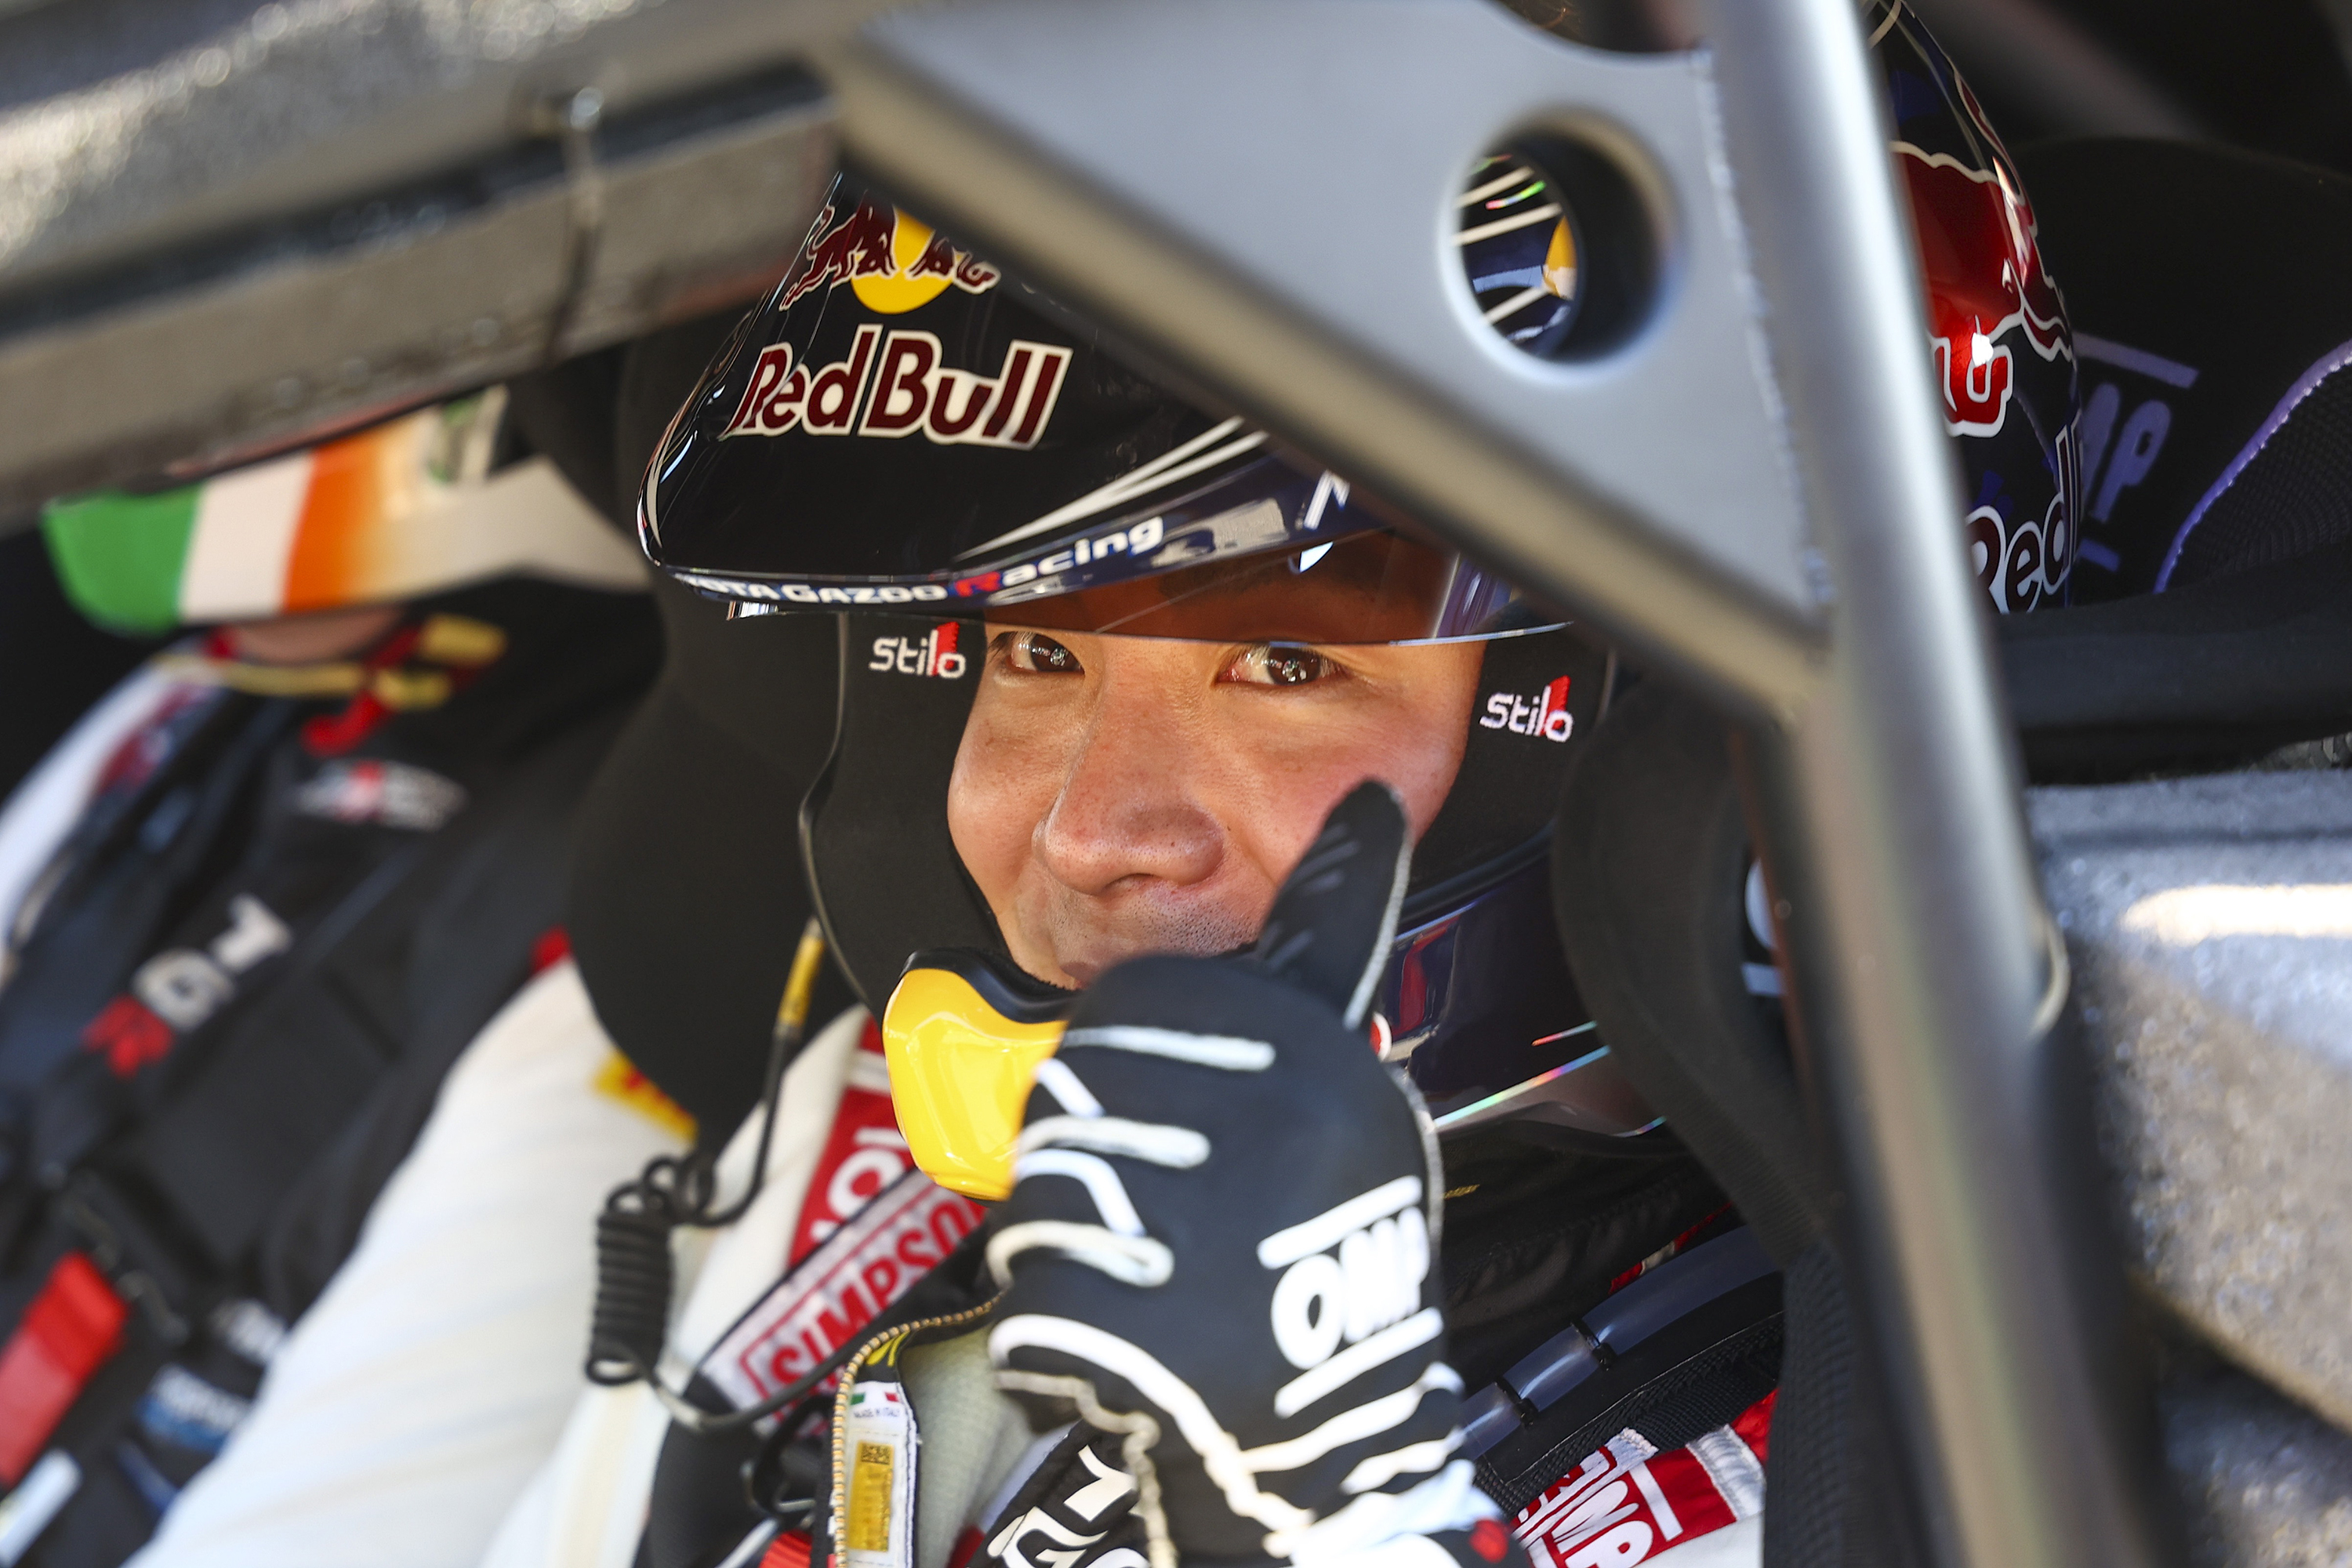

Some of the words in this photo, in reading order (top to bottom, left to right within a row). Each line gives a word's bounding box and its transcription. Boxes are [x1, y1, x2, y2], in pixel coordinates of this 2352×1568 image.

[718, 324, 884, 441] Red
[858, 329, 1074, 451] Bull
[781, 583, 949, 604] GAZOO
[955, 515, 1165, 597] Racing
[868, 627, 967, 679] Stilo
[1479, 682, 1574, 742] Stilo
